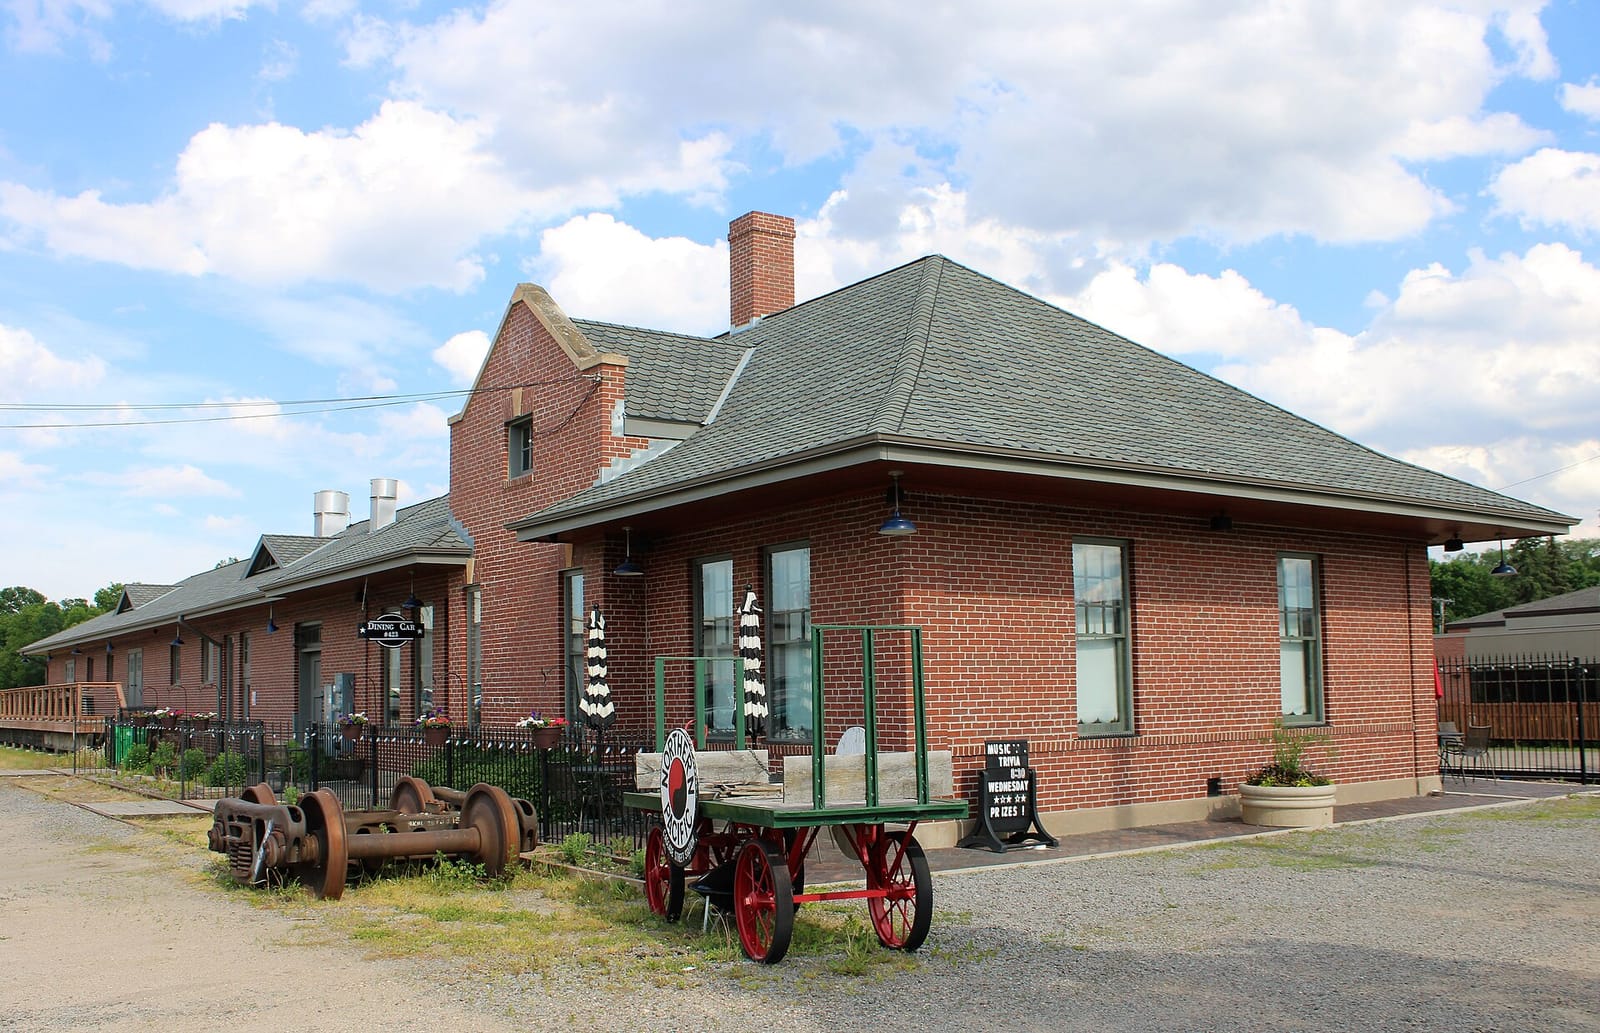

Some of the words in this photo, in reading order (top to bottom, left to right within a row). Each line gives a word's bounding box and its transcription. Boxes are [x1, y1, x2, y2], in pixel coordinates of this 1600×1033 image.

[987, 743, 1011, 755] MUSIC
[661, 732, 695, 795] NORTHERN
[998, 755, 1021, 767] TRIVIA
[987, 780, 1029, 793] WEDNESDAY
[663, 802, 693, 846] PACIFIC
